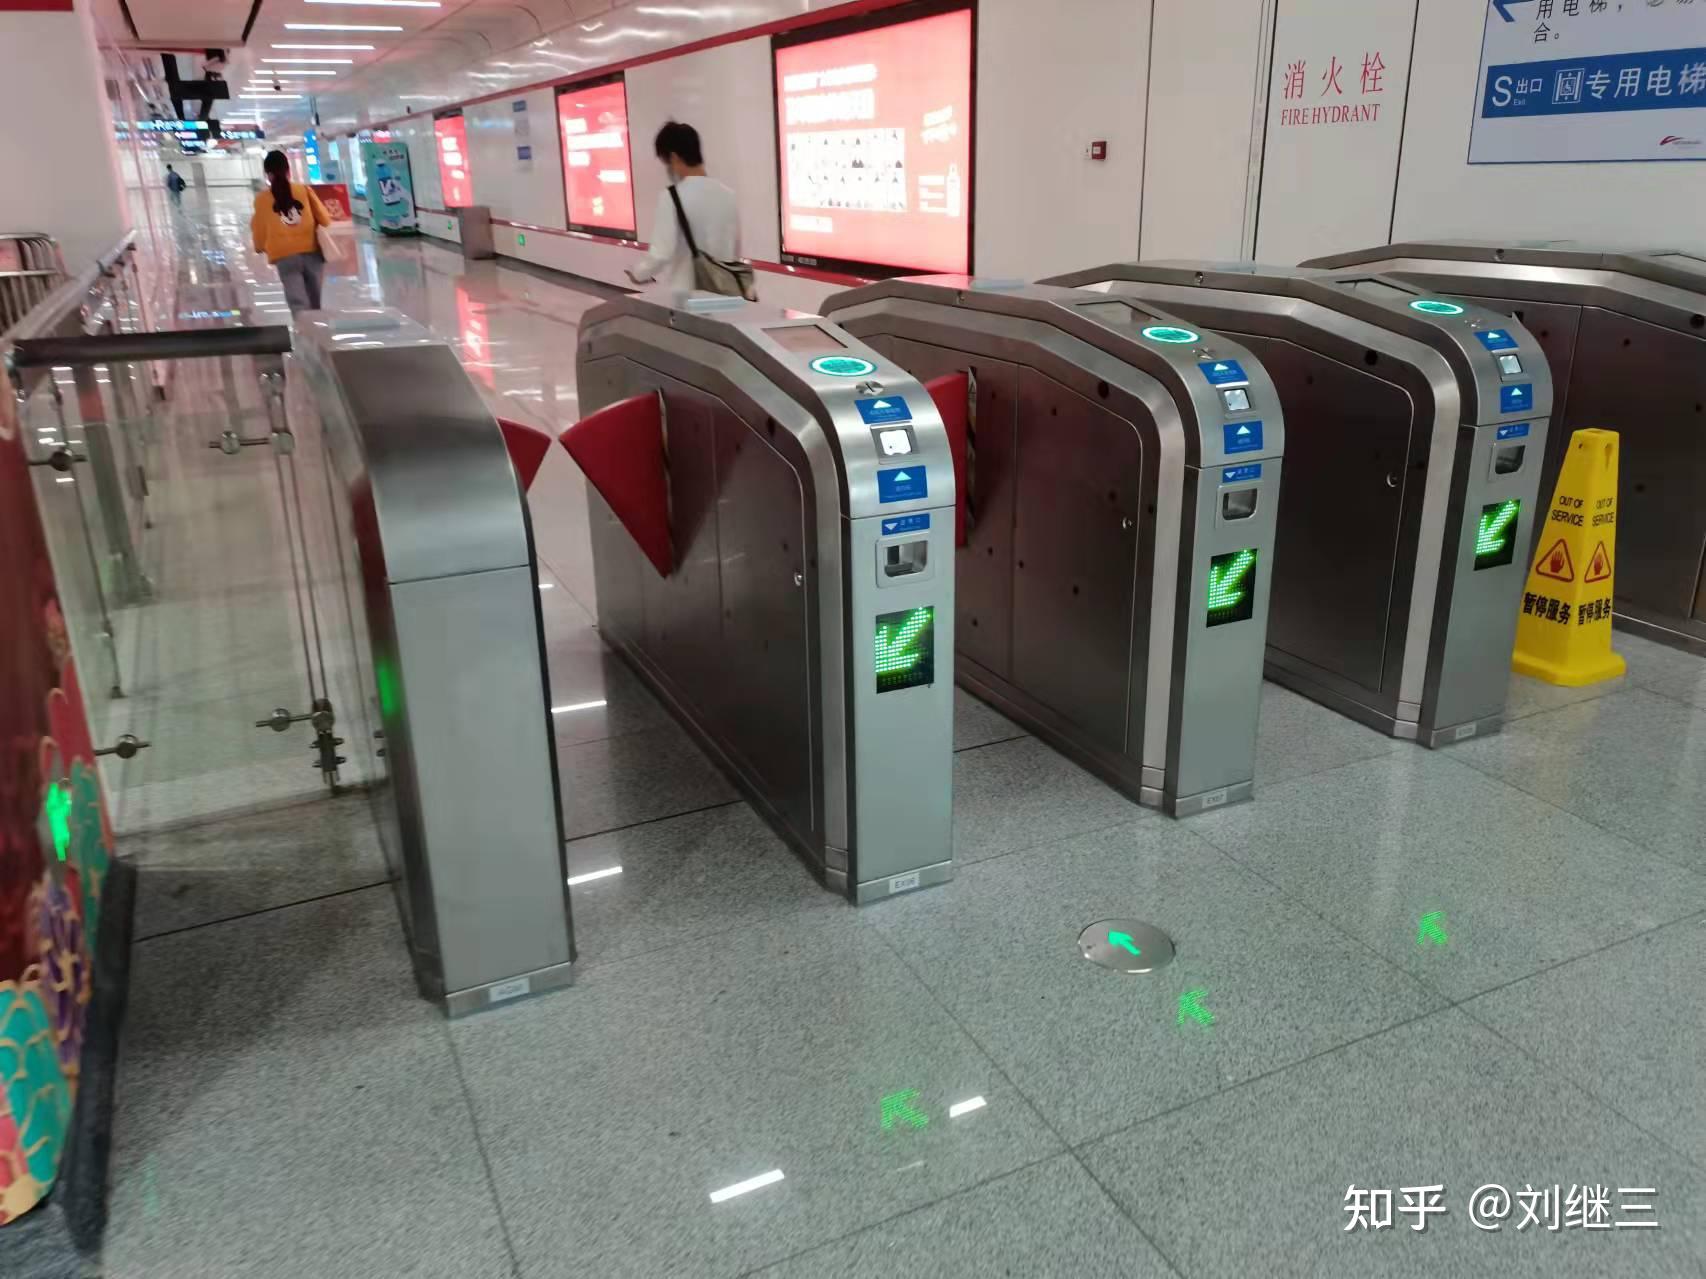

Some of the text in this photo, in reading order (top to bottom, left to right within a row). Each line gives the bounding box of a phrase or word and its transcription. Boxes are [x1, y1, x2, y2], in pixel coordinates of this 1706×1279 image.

[1533, 22, 1560, 43] 合。
[1283, 51, 1386, 101] 消火栓
[1515, 77, 1544, 94] 出口
[1585, 61, 1706, 100] 专用电梯
[1492, 75, 1513, 107] S
[1280, 103, 1381, 126] FIRE HYDRANT
[1559, 496, 1584, 509] OUT OF
[1596, 497, 1613, 509] OUT OF
[1551, 509, 1584, 527] SERVICE
[1592, 511, 1615, 527] SERVICE
[1523, 592, 1571, 625] 暂停服务
[1577, 597, 1612, 626] 暂停服务
